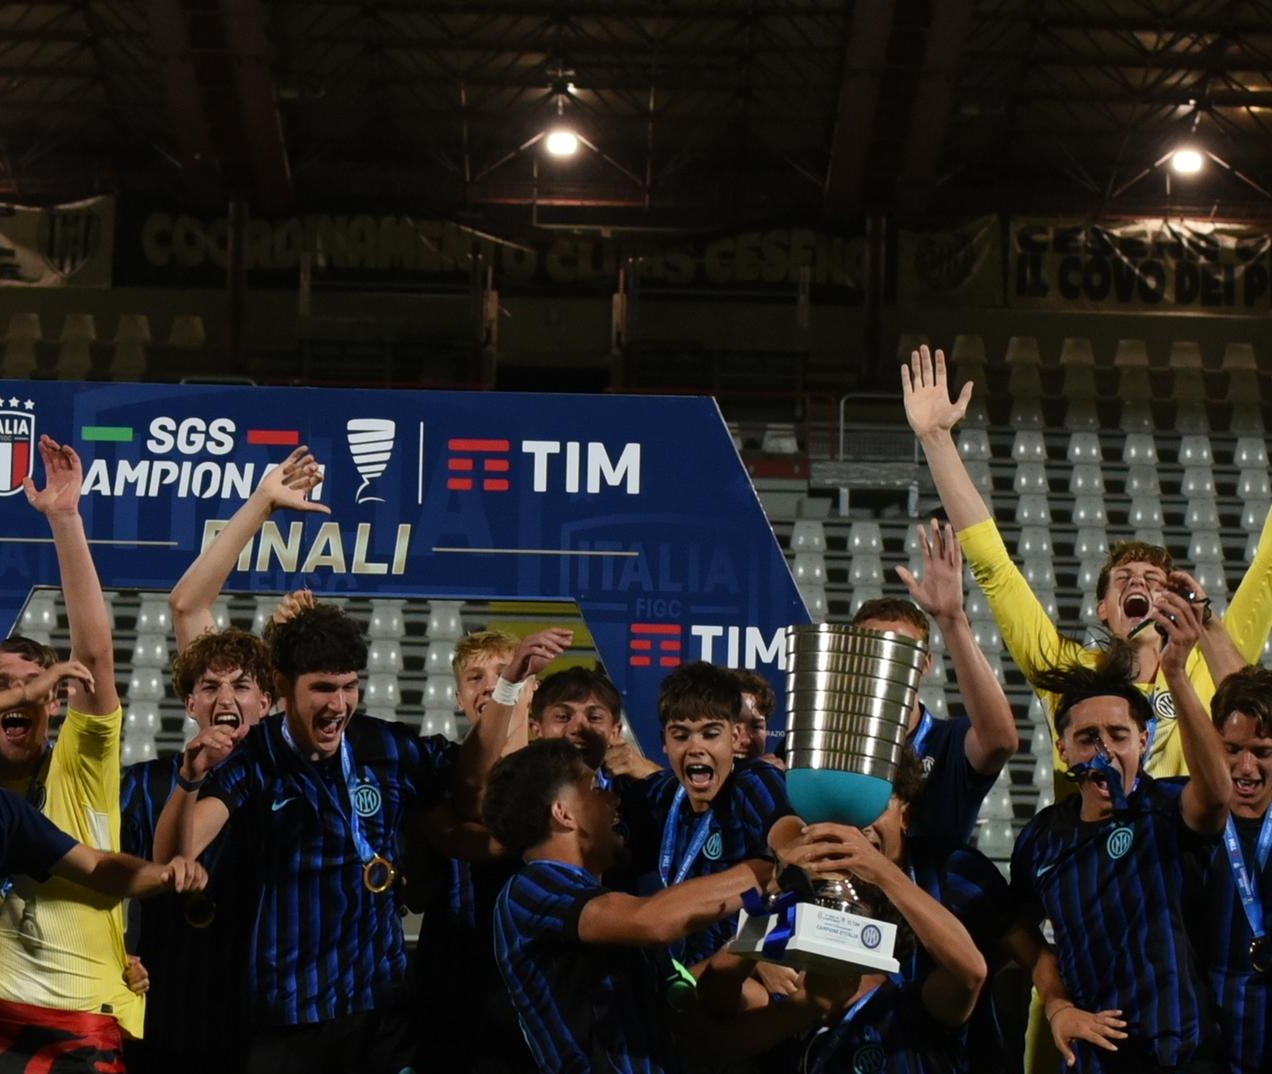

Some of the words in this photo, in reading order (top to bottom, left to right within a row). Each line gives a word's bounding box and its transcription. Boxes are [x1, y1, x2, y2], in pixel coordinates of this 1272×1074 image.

[1016, 254, 1049, 297] IL
[1058, 255, 1166, 304] COVO
[146, 416, 237, 456] SGS
[81, 458, 326, 500] AMPIONI
[521, 440, 641, 494] TIM
[635, 599, 681, 618] FIGC
[691, 624, 786, 671] TIM
